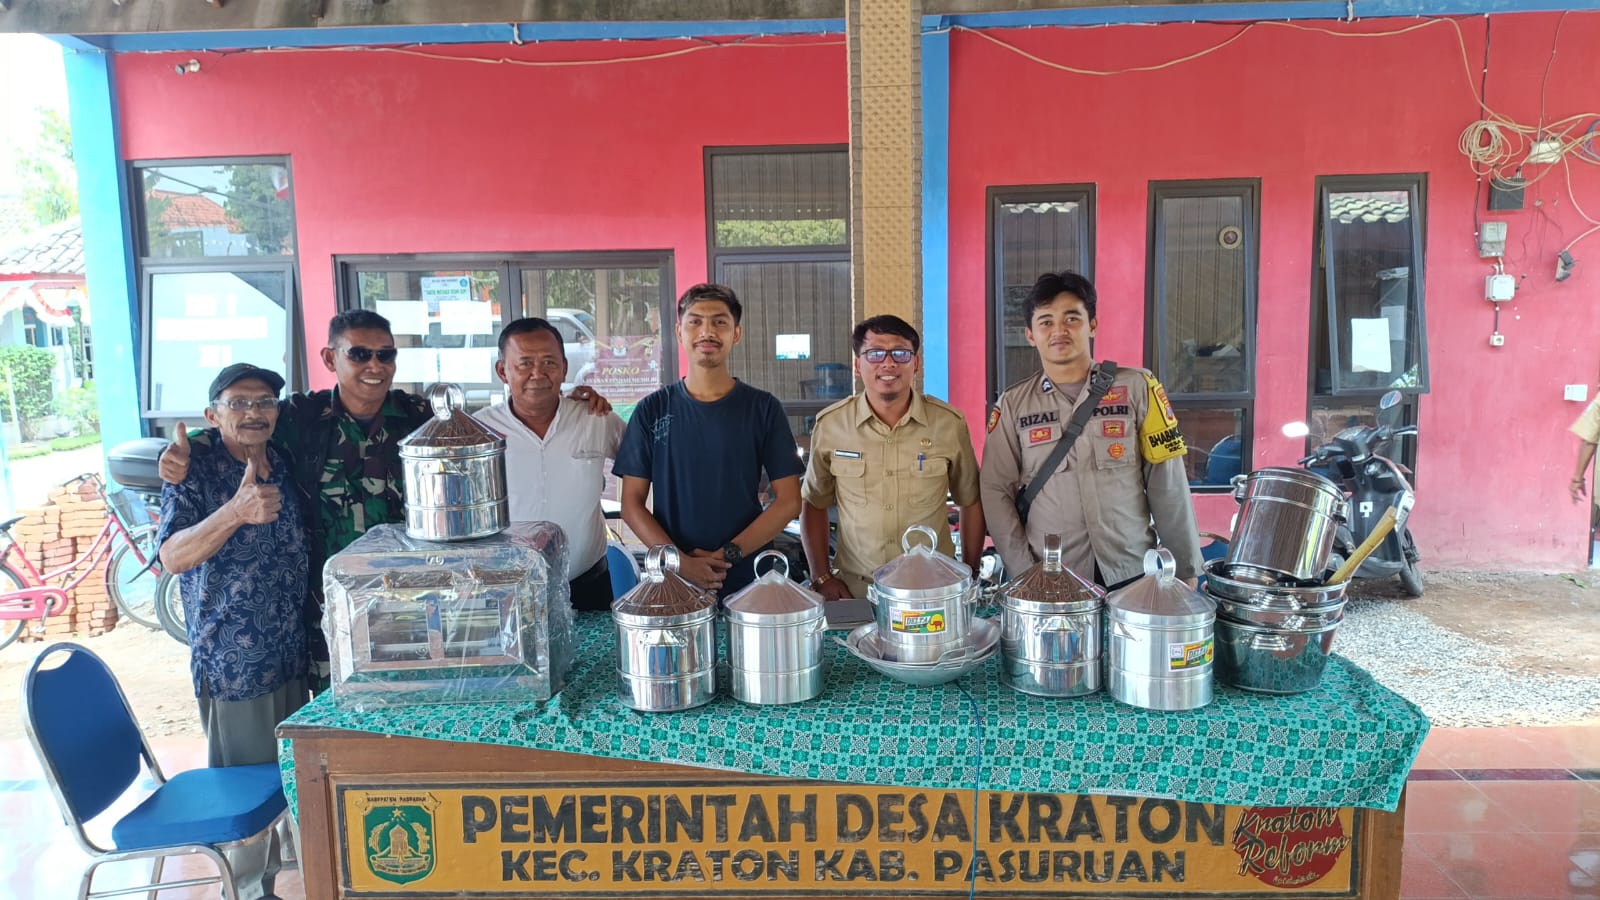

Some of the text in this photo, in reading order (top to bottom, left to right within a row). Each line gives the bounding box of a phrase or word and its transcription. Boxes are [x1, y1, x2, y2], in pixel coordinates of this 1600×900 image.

[601, 367, 640, 375] POSKO
[1020, 412, 1057, 427] RIZAL
[1093, 405, 1128, 417] POLRI
[462, 793, 1225, 846] PEMERINTAH DESA KRATON
[1232, 806, 1338, 843] Kraton
[502, 849, 1185, 883] KEC. KRATON KAB. PASURUAN
[1237, 834, 1350, 877] Reform
